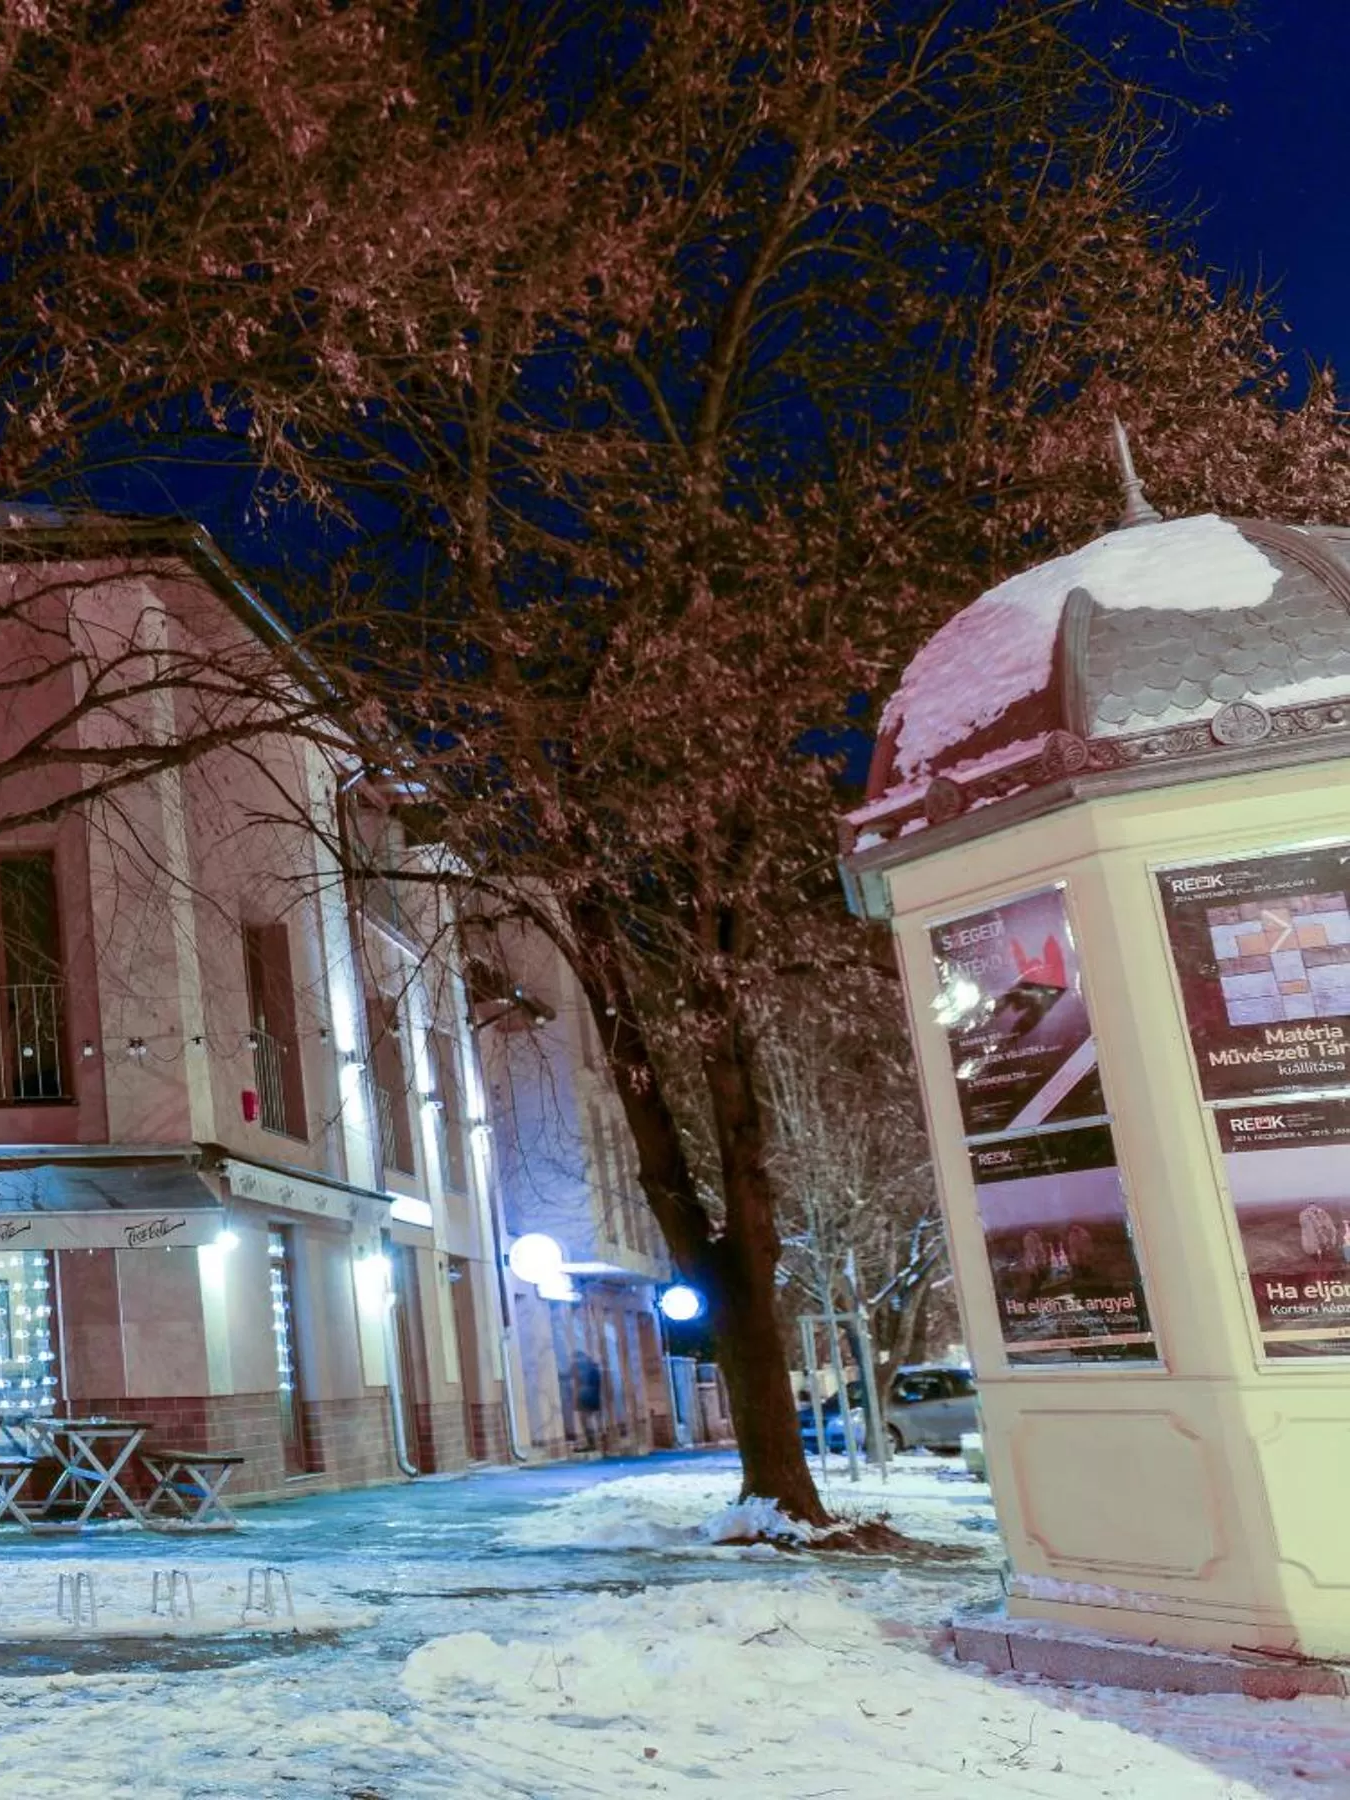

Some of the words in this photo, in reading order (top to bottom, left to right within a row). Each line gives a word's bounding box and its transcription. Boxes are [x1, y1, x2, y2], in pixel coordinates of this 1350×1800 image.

[1264, 1025, 1344, 1045] Matéria
[1208, 1043, 1310, 1067] Művészeti
[1277, 1060, 1346, 1075] kiállítása
[1266, 1283, 1298, 1300] Ha
[1085, 1292, 1137, 1313] angyal
